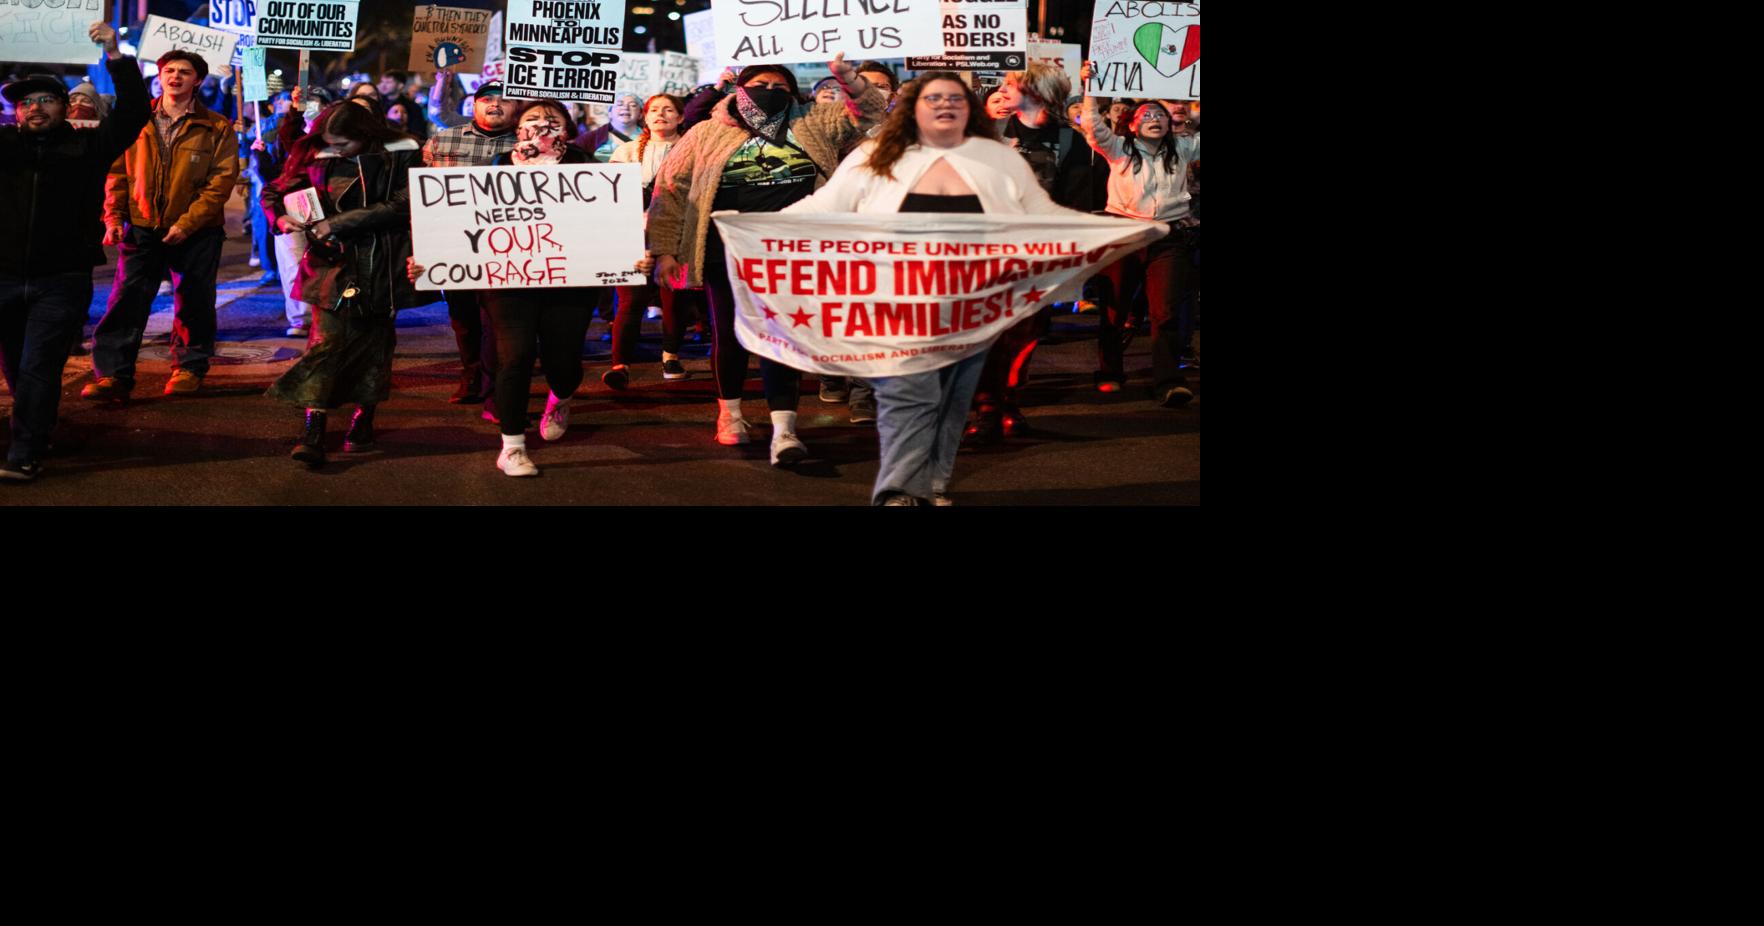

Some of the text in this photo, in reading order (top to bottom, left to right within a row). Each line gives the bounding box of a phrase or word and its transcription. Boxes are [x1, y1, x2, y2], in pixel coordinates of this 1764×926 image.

[211, 0, 256, 27] STOP
[267, 1, 346, 20] OUT OF OUR
[532, 0, 601, 20] PHOENIX
[258, 18, 353, 38] COMMUNITIES
[942, 14, 1000, 29] AS NO
[153, 22, 224, 52] ABOLISH
[258, 37, 275, 45] PARTY
[275, 38, 286, 46] FOR
[286, 39, 314, 47] SOCIALISM
[321, 41, 351, 49] LIBERATION
[509, 22, 620, 45] MINNEAPOLIS
[732, 35, 784, 60] ALL
[801, 28, 841, 53] OF
[858, 27, 903, 49] US
[943, 31, 1015, 47] RDERS!
[509, 47, 620, 67] STOP
[507, 64, 538, 86] ICE
[541, 66, 617, 91] TERROR
[539, 91, 570, 100] SOCIALISM
[579, 94, 613, 102] LIBERATION
[418, 171, 622, 207] DEMOCRACY
[475, 207, 546, 225] NEEDS
[463, 223, 564, 257] YOUR
[761, 239, 1086, 256] THE PEOPLE UNITED WILL
[428, 257, 567, 287] COURAGE
[821, 287, 1015, 338] FAMILIES!
[811, 352, 886, 363] SOCIALISM
[891, 348, 922, 359] AND
